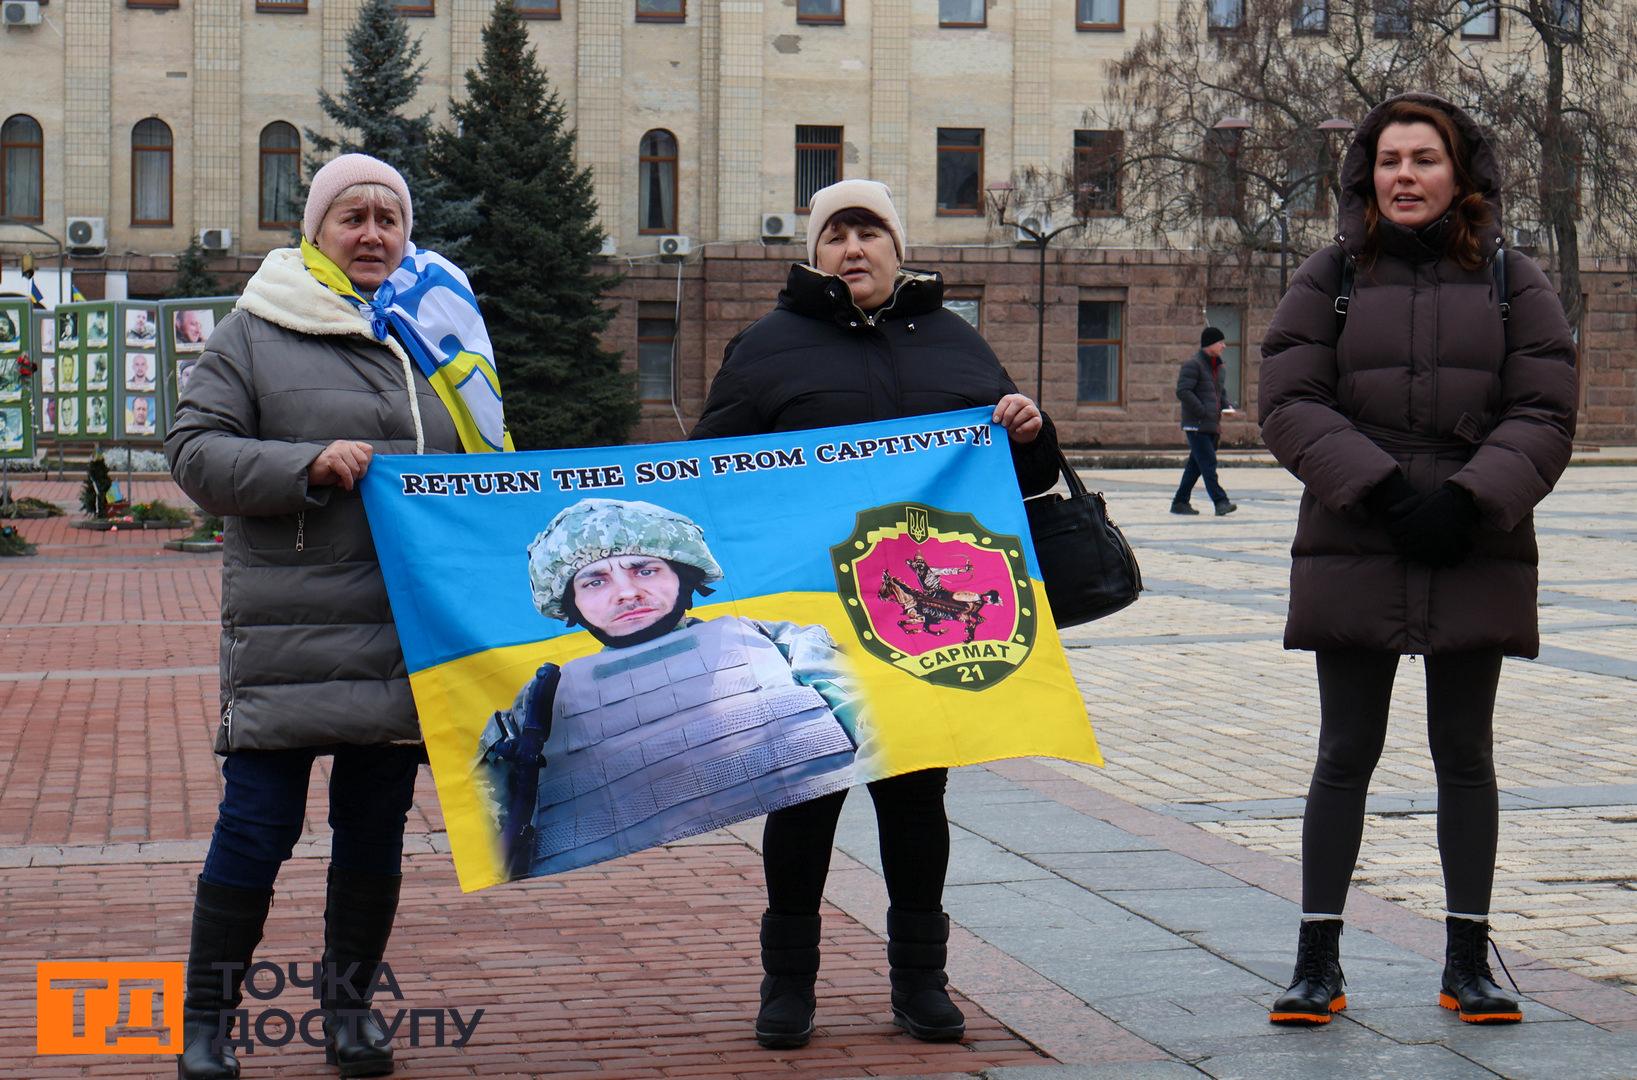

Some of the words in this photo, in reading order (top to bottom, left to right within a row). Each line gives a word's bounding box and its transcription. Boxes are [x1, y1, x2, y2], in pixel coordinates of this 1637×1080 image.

[401, 472, 541, 496] RETURN
[552, 465, 624, 490] THE
[636, 458, 700, 484] SON
[711, 448, 806, 475] FROM
[816, 425, 992, 463] CAPTIVITY!
[919, 644, 1010, 669] САРМАТ
[957, 664, 985, 682] 21
